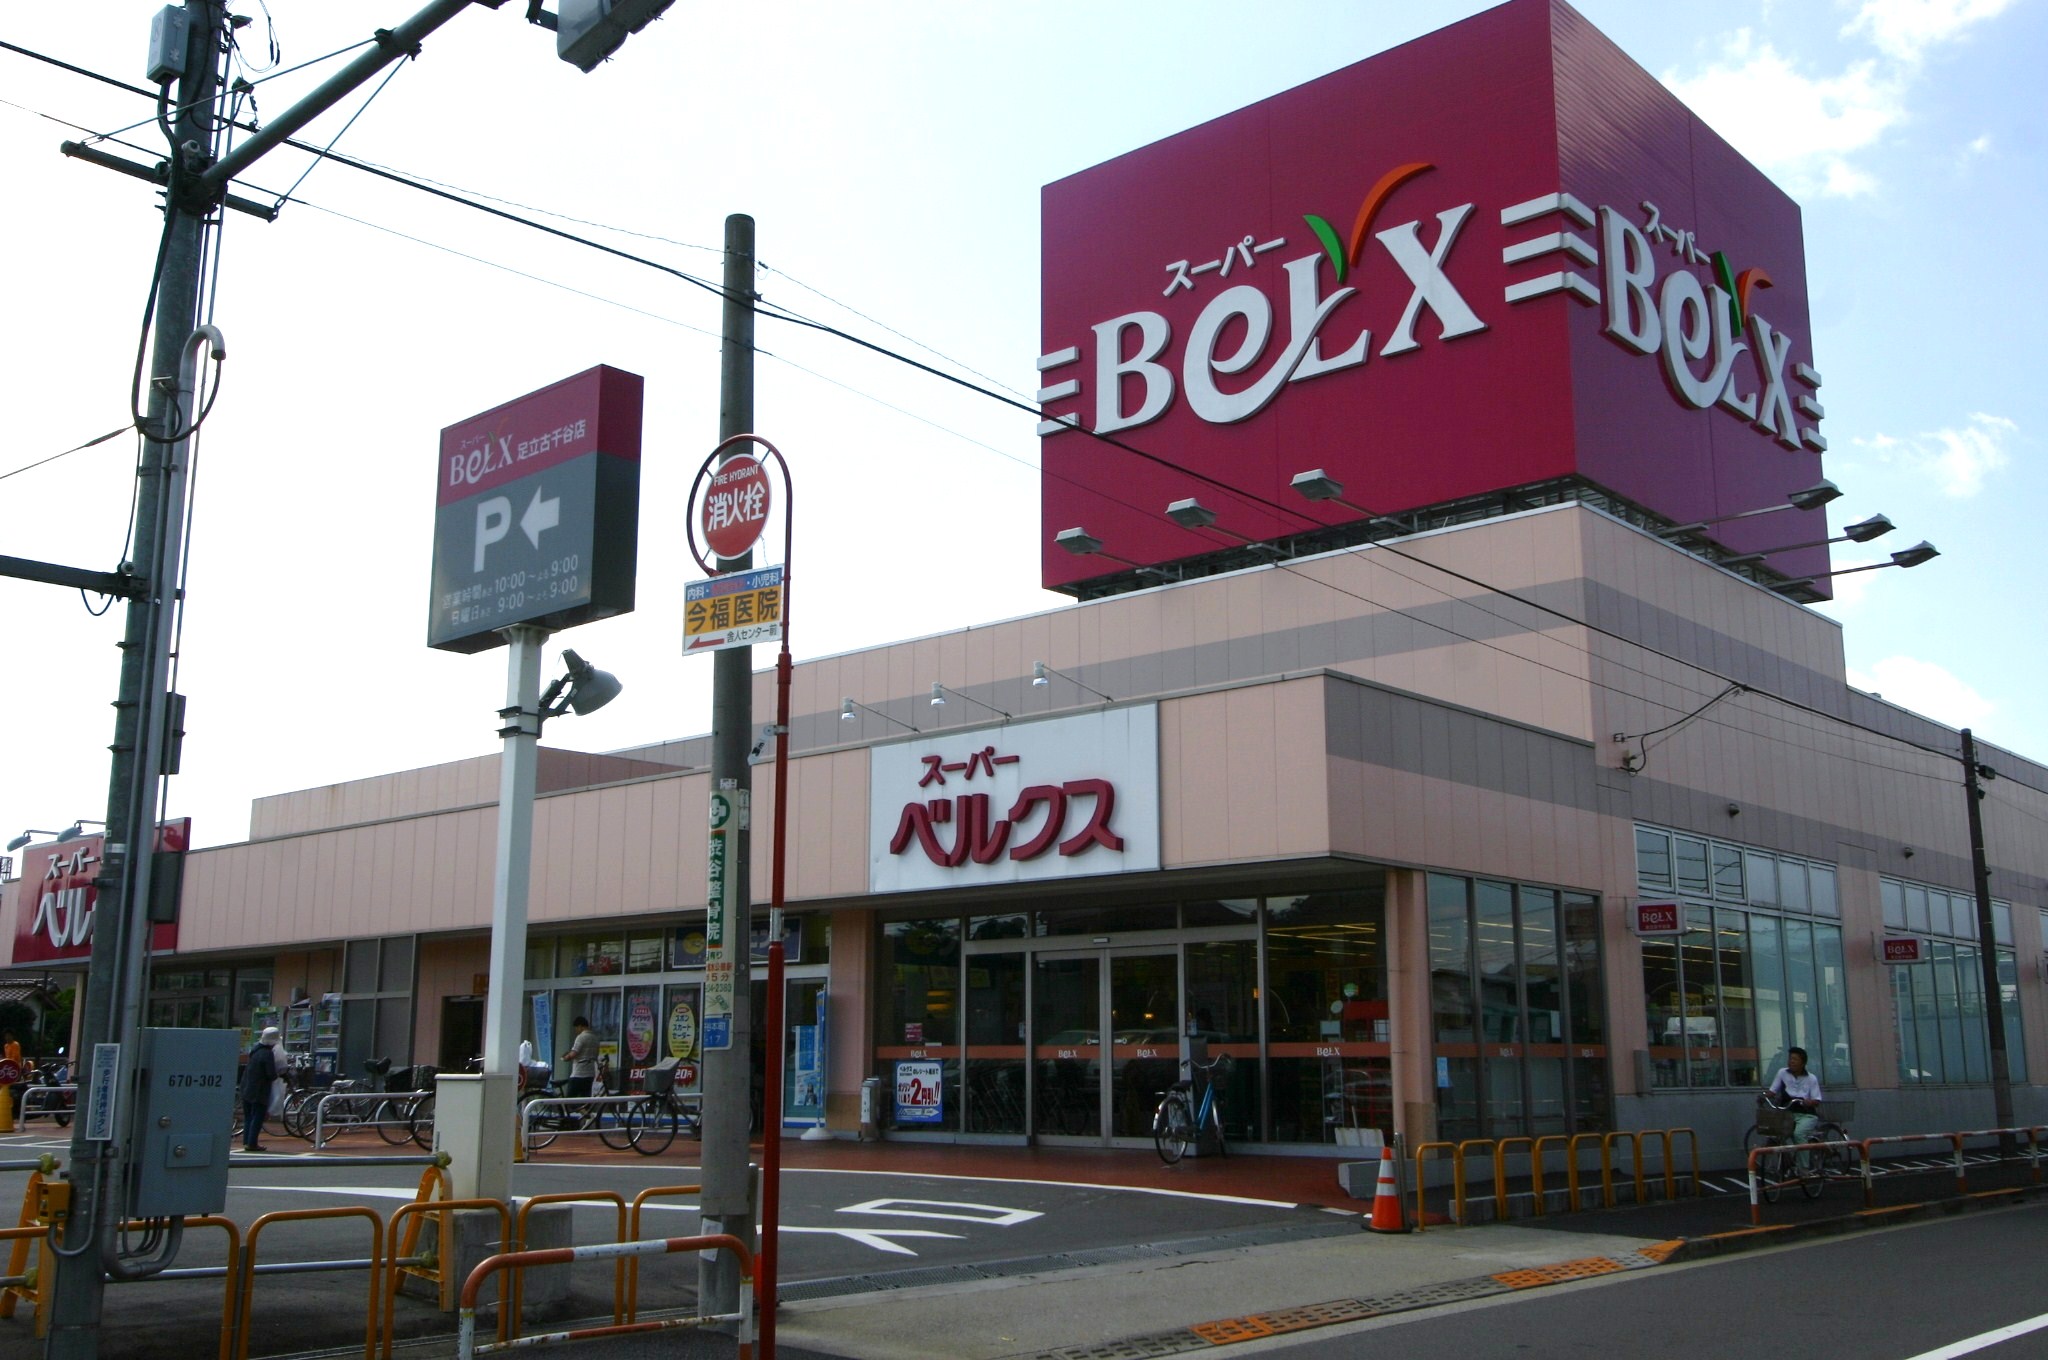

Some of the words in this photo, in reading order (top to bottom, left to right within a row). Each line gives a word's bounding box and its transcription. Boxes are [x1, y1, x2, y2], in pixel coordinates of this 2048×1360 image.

[1642, 200, 1712, 264] スーパー
[1162, 234, 1287, 298] スーパー
[460, 434, 486, 451] スーパー
[516, 418, 587, 462] 足立古千谷店
[714, 473, 728, 487] FIRE
[729, 463, 759, 482] HYDRANT
[707, 480, 766, 532] 消火栓
[473, 494, 512, 574] P
[687, 588, 778, 633] 今福医院
[727, 624, 777, 643] 舎人センター前
[918, 745, 1020, 787] スーパー
[889, 778, 1124, 868] ベルクス
[44, 846, 98, 881] スーパー
[168, 1074, 223, 1088] 670-302
